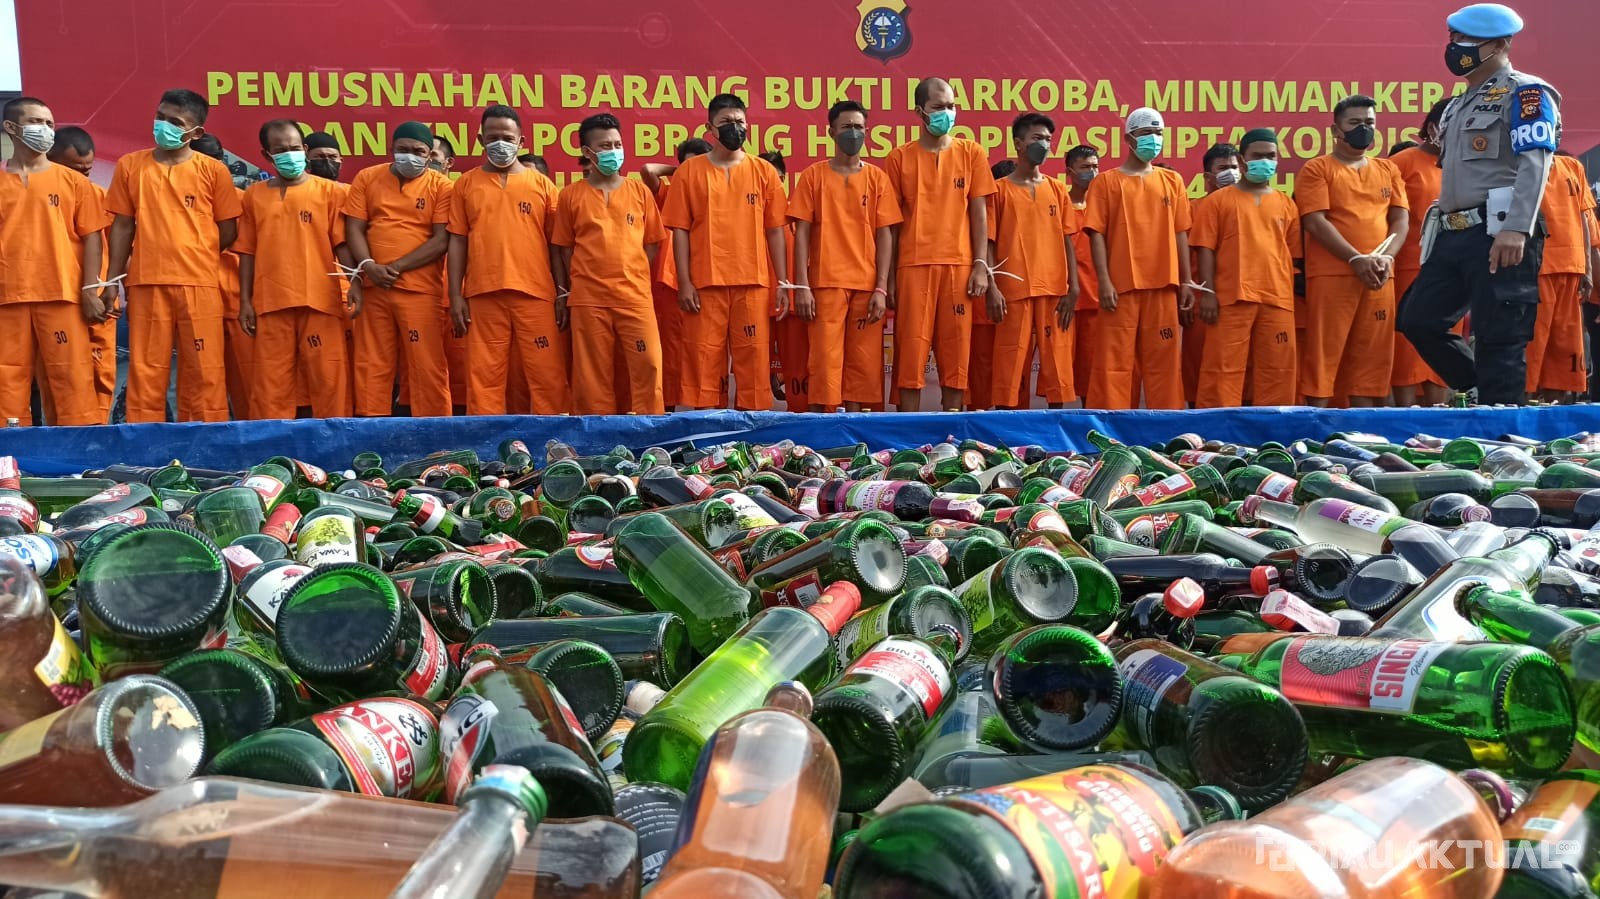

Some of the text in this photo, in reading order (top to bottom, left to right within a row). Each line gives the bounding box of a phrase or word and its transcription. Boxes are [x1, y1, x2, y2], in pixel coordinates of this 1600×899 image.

[206, 71, 544, 107] PEMUSNAHAN
[560, 74, 749, 110] BARANG
[766, 76, 892, 111] BUKTI
[1144, 79, 1360, 113] MINUMAN
[1367, 80, 1469, 113] KER
[1471, 103, 1505, 113] POLRI
[949, 125, 1121, 159] OPASI
[1161, 126, 1246, 159] IPTA
[48, 193, 59, 207] 30
[184, 195, 195, 208] 57
[415, 197, 425, 210] 29
[517, 201, 532, 215] 150
[1048, 204, 1057, 217] 37
[299, 210, 312, 224] 161
[952, 303, 965, 316] 148
[54, 330, 67, 345] 30
[409, 329, 419, 343] 29
[743, 324, 756, 337] 187
[193, 338, 205, 351] 57
[307, 333, 322, 348] 161
[533, 335, 549, 349] 150
